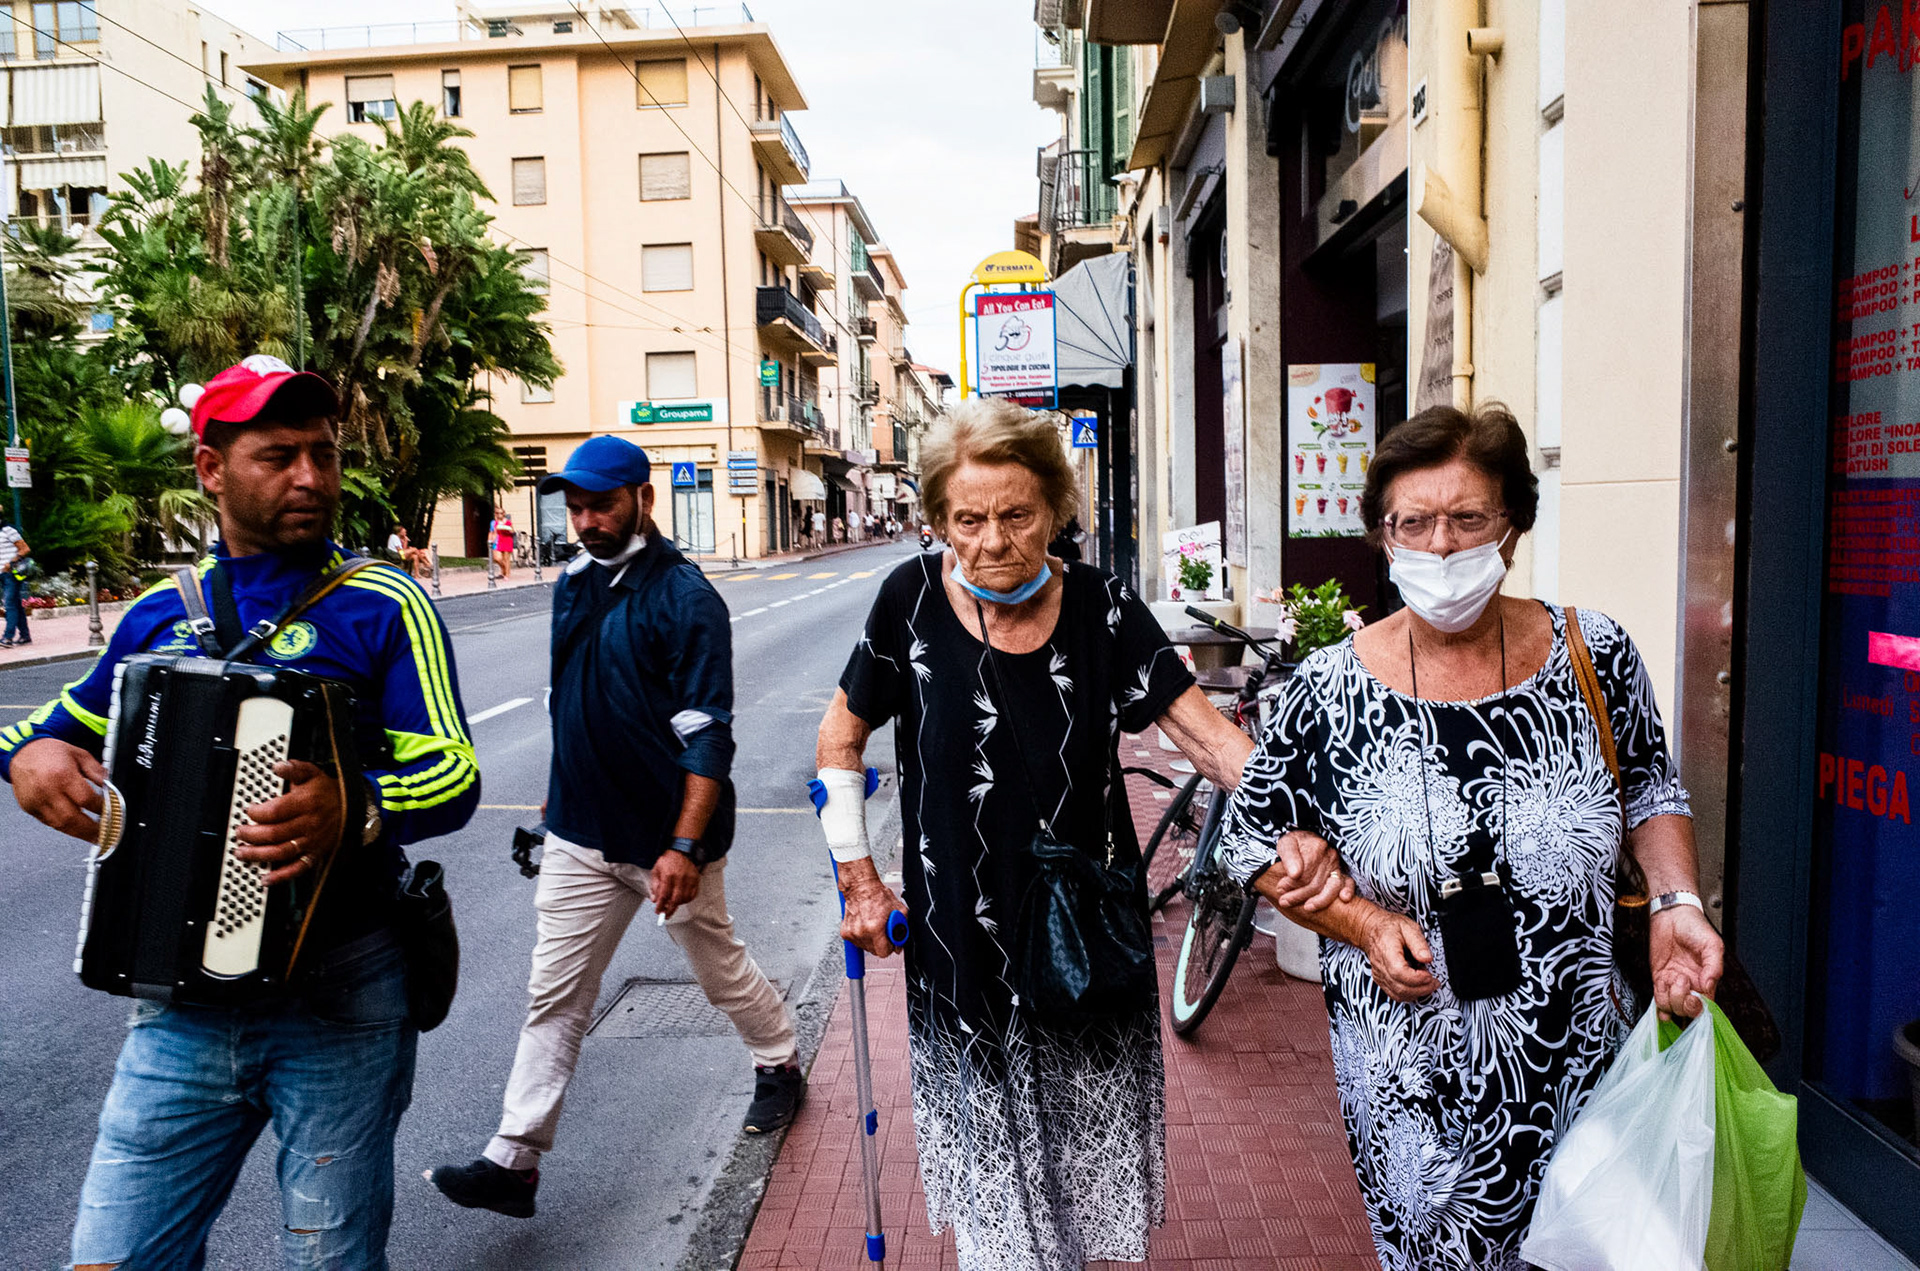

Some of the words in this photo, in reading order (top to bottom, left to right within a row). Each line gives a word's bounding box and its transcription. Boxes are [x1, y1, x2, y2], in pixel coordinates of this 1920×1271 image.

[983, 304, 994, 315] All
[996, 303, 1013, 313] You
[1014, 301, 1030, 311] Can
[1031, 299, 1046, 309] Eat
[660, 410, 708, 419] Groupama
[1871, 442, 1883, 456] DI
[1887, 439, 1920, 455] SOLE
[1819, 752, 1912, 824] PIEGA
